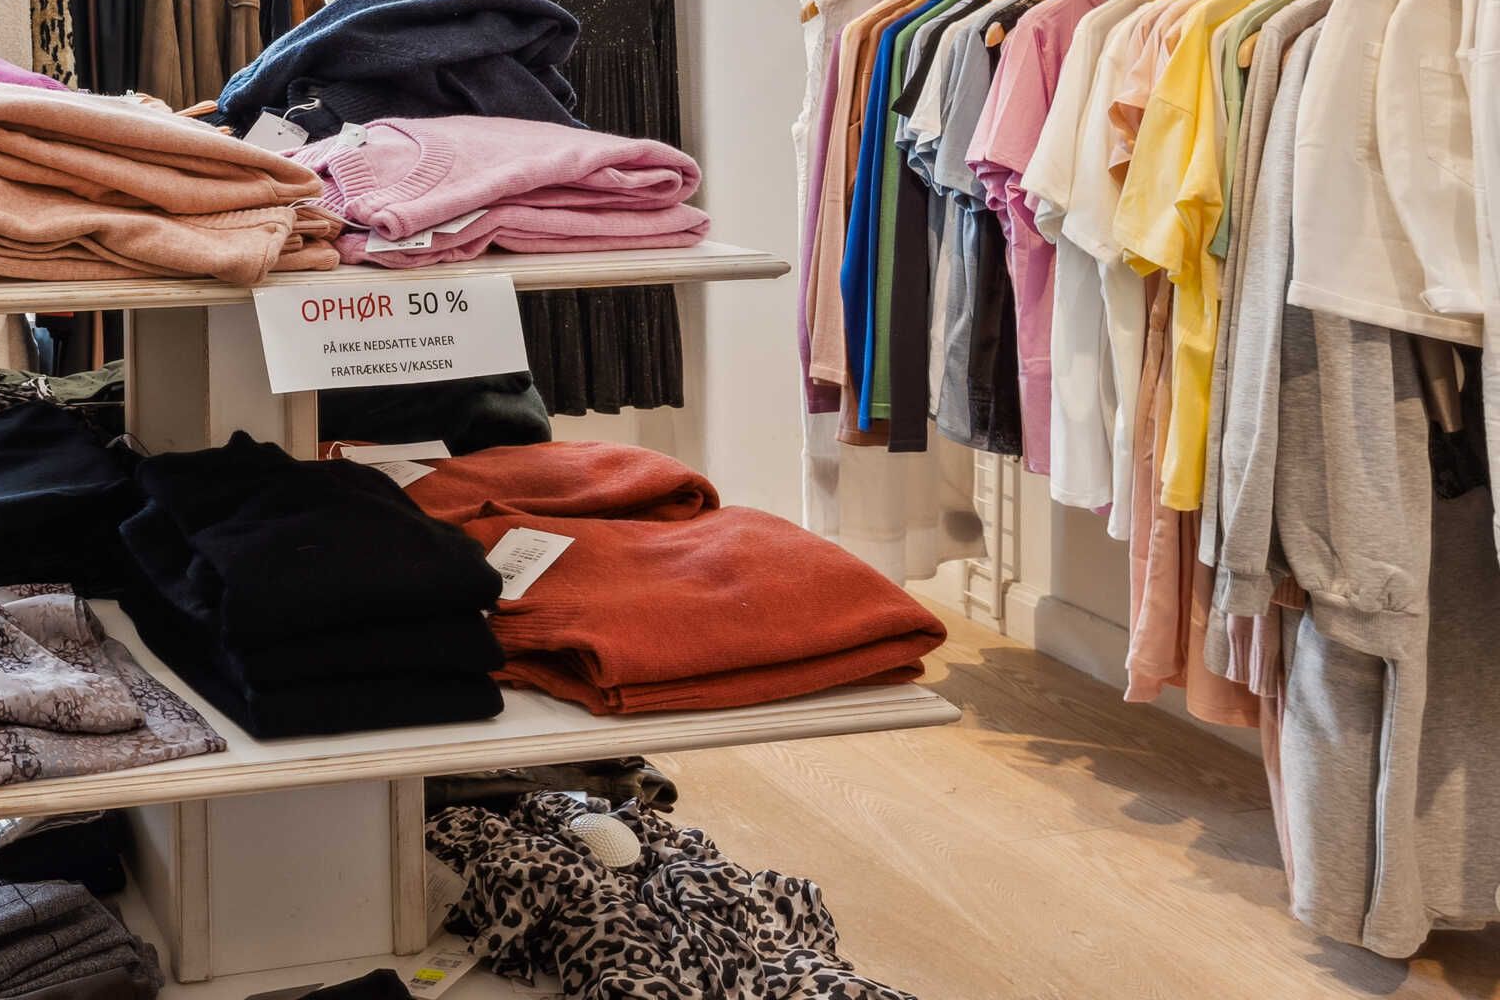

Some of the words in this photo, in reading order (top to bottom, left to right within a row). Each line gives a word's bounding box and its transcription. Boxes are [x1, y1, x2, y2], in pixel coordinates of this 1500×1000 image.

[301, 292, 394, 322] OPHØR
[408, 292, 439, 316] 50
[445, 289, 469, 313] %
[323, 341, 337, 354] PÅ
[339, 340, 361, 353] IKKE
[364, 337, 417, 352] NEDSATTE
[419, 335, 455, 347] VARER
[331, 362, 398, 377] FRATRÆKKES
[400, 359, 453, 373] V/KASSEN
